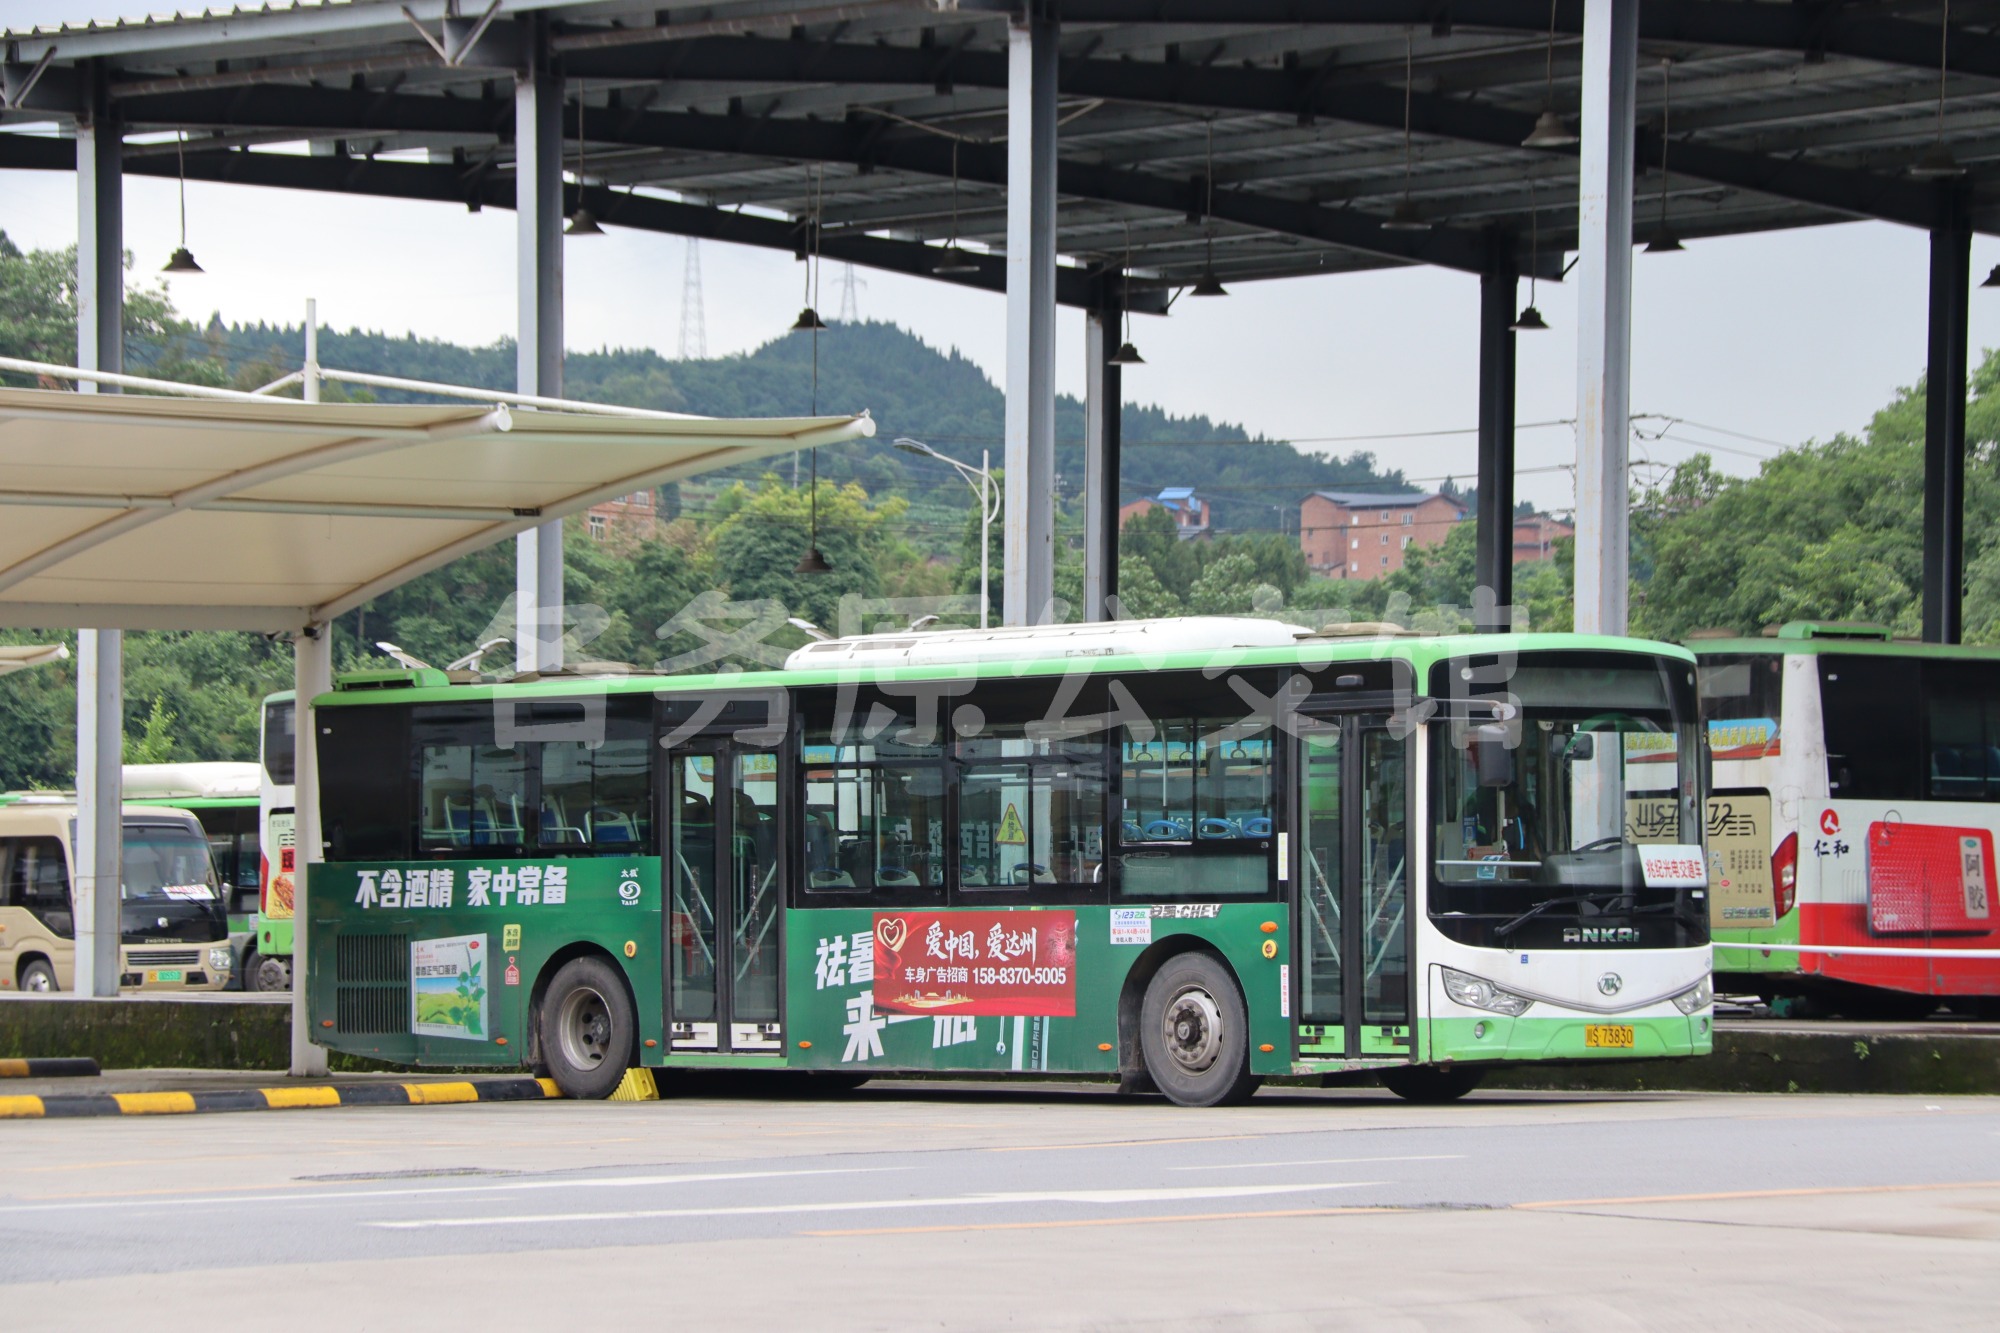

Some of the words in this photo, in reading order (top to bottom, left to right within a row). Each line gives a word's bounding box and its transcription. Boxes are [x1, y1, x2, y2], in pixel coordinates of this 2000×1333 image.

[1704, 726, 1767, 747] 动高质量发展
[1814, 839, 1850, 858] 仁和
[355, 868, 455, 909] 不含酒精
[466, 865, 568, 906] 家中常备
[1964, 853, 1986, 911] 阿胶
[904, 966, 968, 984] 车身广告招商
[972, 967, 1067, 985] 158-8370-5005
